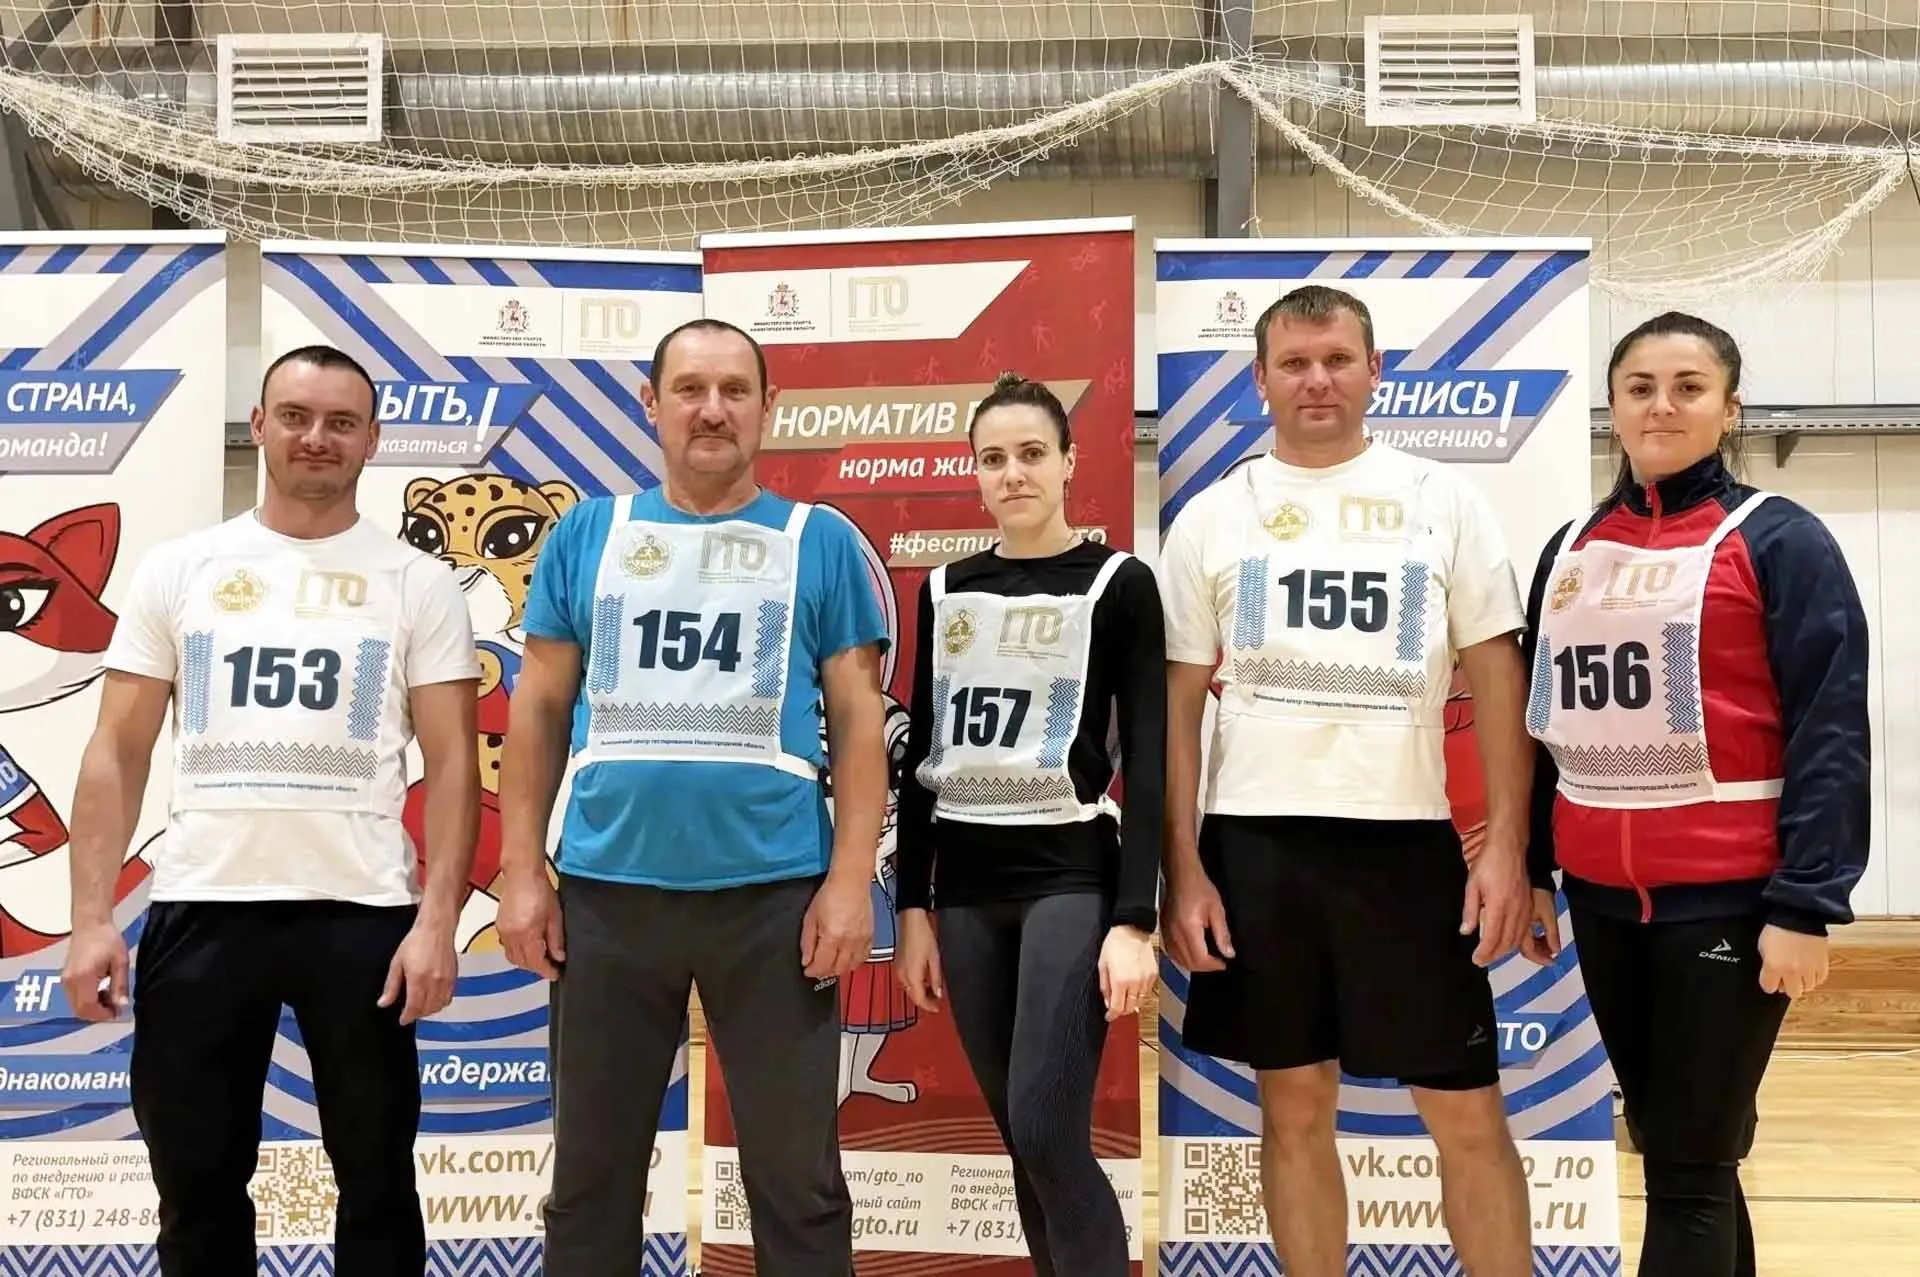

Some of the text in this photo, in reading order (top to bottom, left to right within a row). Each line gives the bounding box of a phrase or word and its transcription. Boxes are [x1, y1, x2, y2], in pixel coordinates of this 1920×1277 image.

[7, 382, 136, 416] СТРАНА,
[376, 385, 473, 426] ЫТЬ,
[772, 402, 957, 437] НОРМАТИВ
[839, 456, 925, 485] норма
[889, 532, 1000, 559] #фести
[1278, 568, 1389, 633] 155
[632, 609, 742, 673] 154
[223, 645, 342, 711] 153
[1553, 640, 1652, 711] 156
[950, 686, 1033, 749] 157
[1497, 1021, 1547, 1051] ТО
[0, 1066, 131, 1091] днакоман
[420, 1055, 551, 1090] кдержа
[13, 1153, 108, 1167] Региональный
[951, 1164, 1014, 1179] Регионал
[11, 1173, 29, 1184] по
[32, 1170, 104, 1184] внедрению
[109, 1173, 118, 1183] и
[951, 1183, 1014, 1198] по внедре
[12, 1187, 50, 1201] ВФСК
[886, 1197, 922, 1210] сайт
[951, 1197, 989, 1211] ВФСК
[8, 1209, 31, 1228] +7
[35, 1208, 86, 1233] (831)
[852, 1215, 919, 1241] gto.ru
[946, 1219, 1024, 1244] +7 (831)
